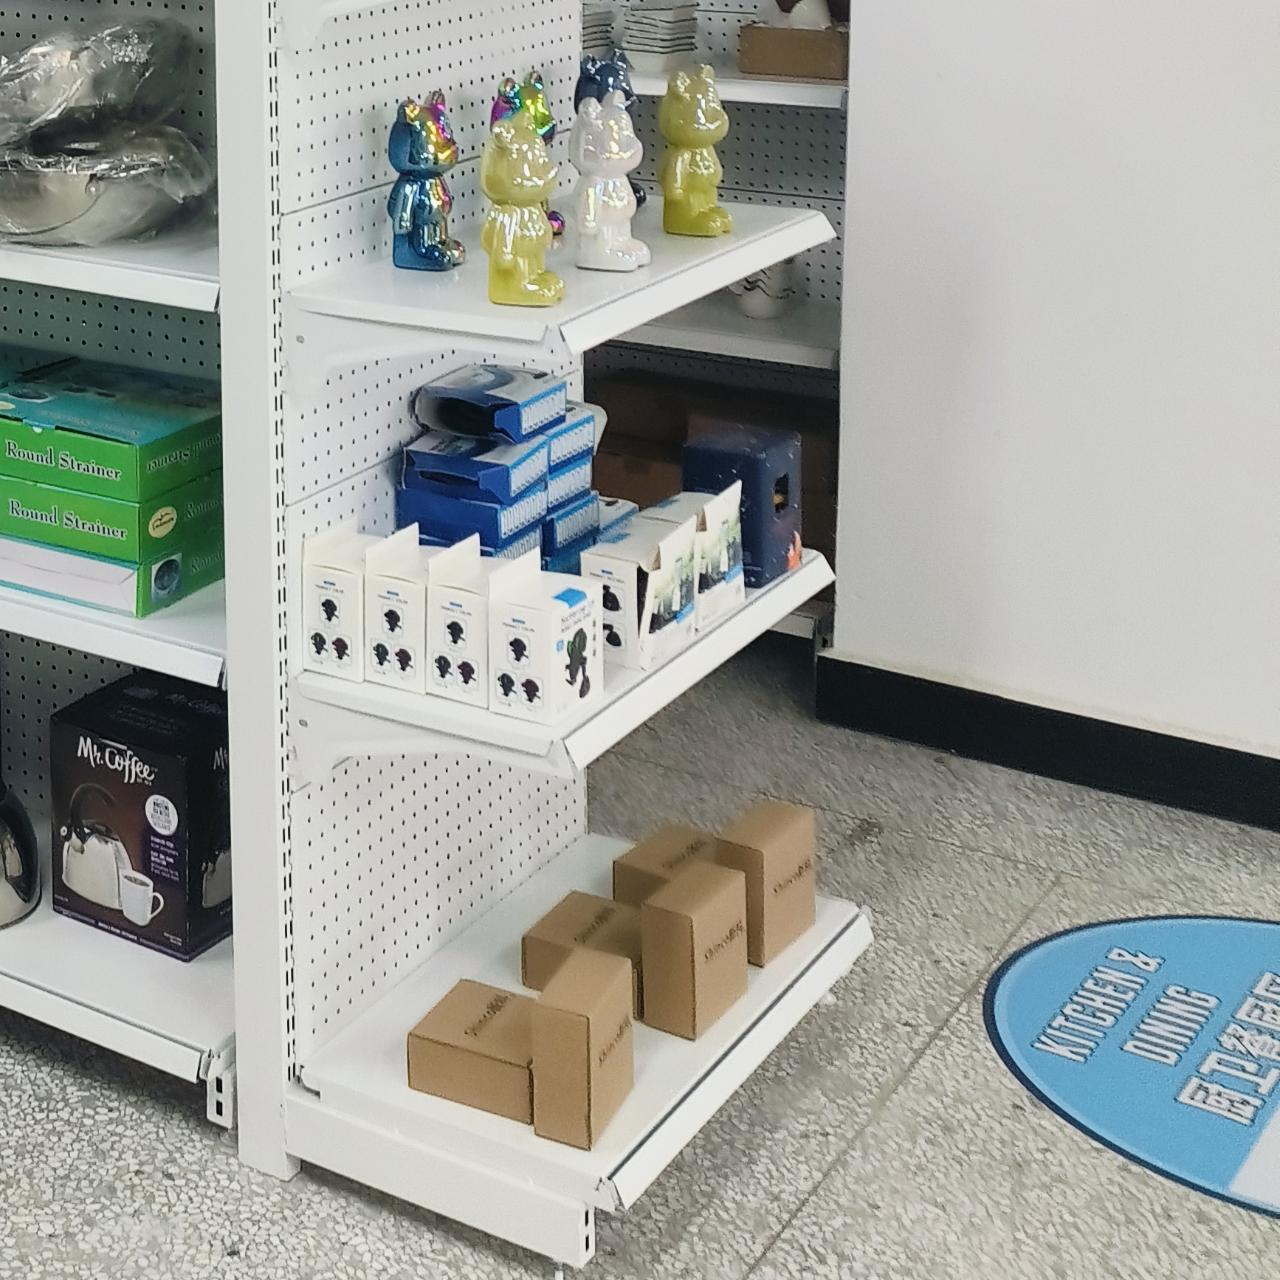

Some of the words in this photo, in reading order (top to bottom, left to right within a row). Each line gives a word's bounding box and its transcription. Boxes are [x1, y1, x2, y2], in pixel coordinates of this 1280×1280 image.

[6, 439, 55, 466] Round
[59, 451, 122, 481] Strainer
[9, 499, 59, 525] Round
[63, 511, 127, 541] Strainer
[77, 735, 104, 768] Mr.
[105, 747, 155, 784] Coffee
[1031, 965, 1150, 1064] KITCHEN
[1105, 946, 1166, 973] &
[1120, 984, 1221, 1067] DINING
